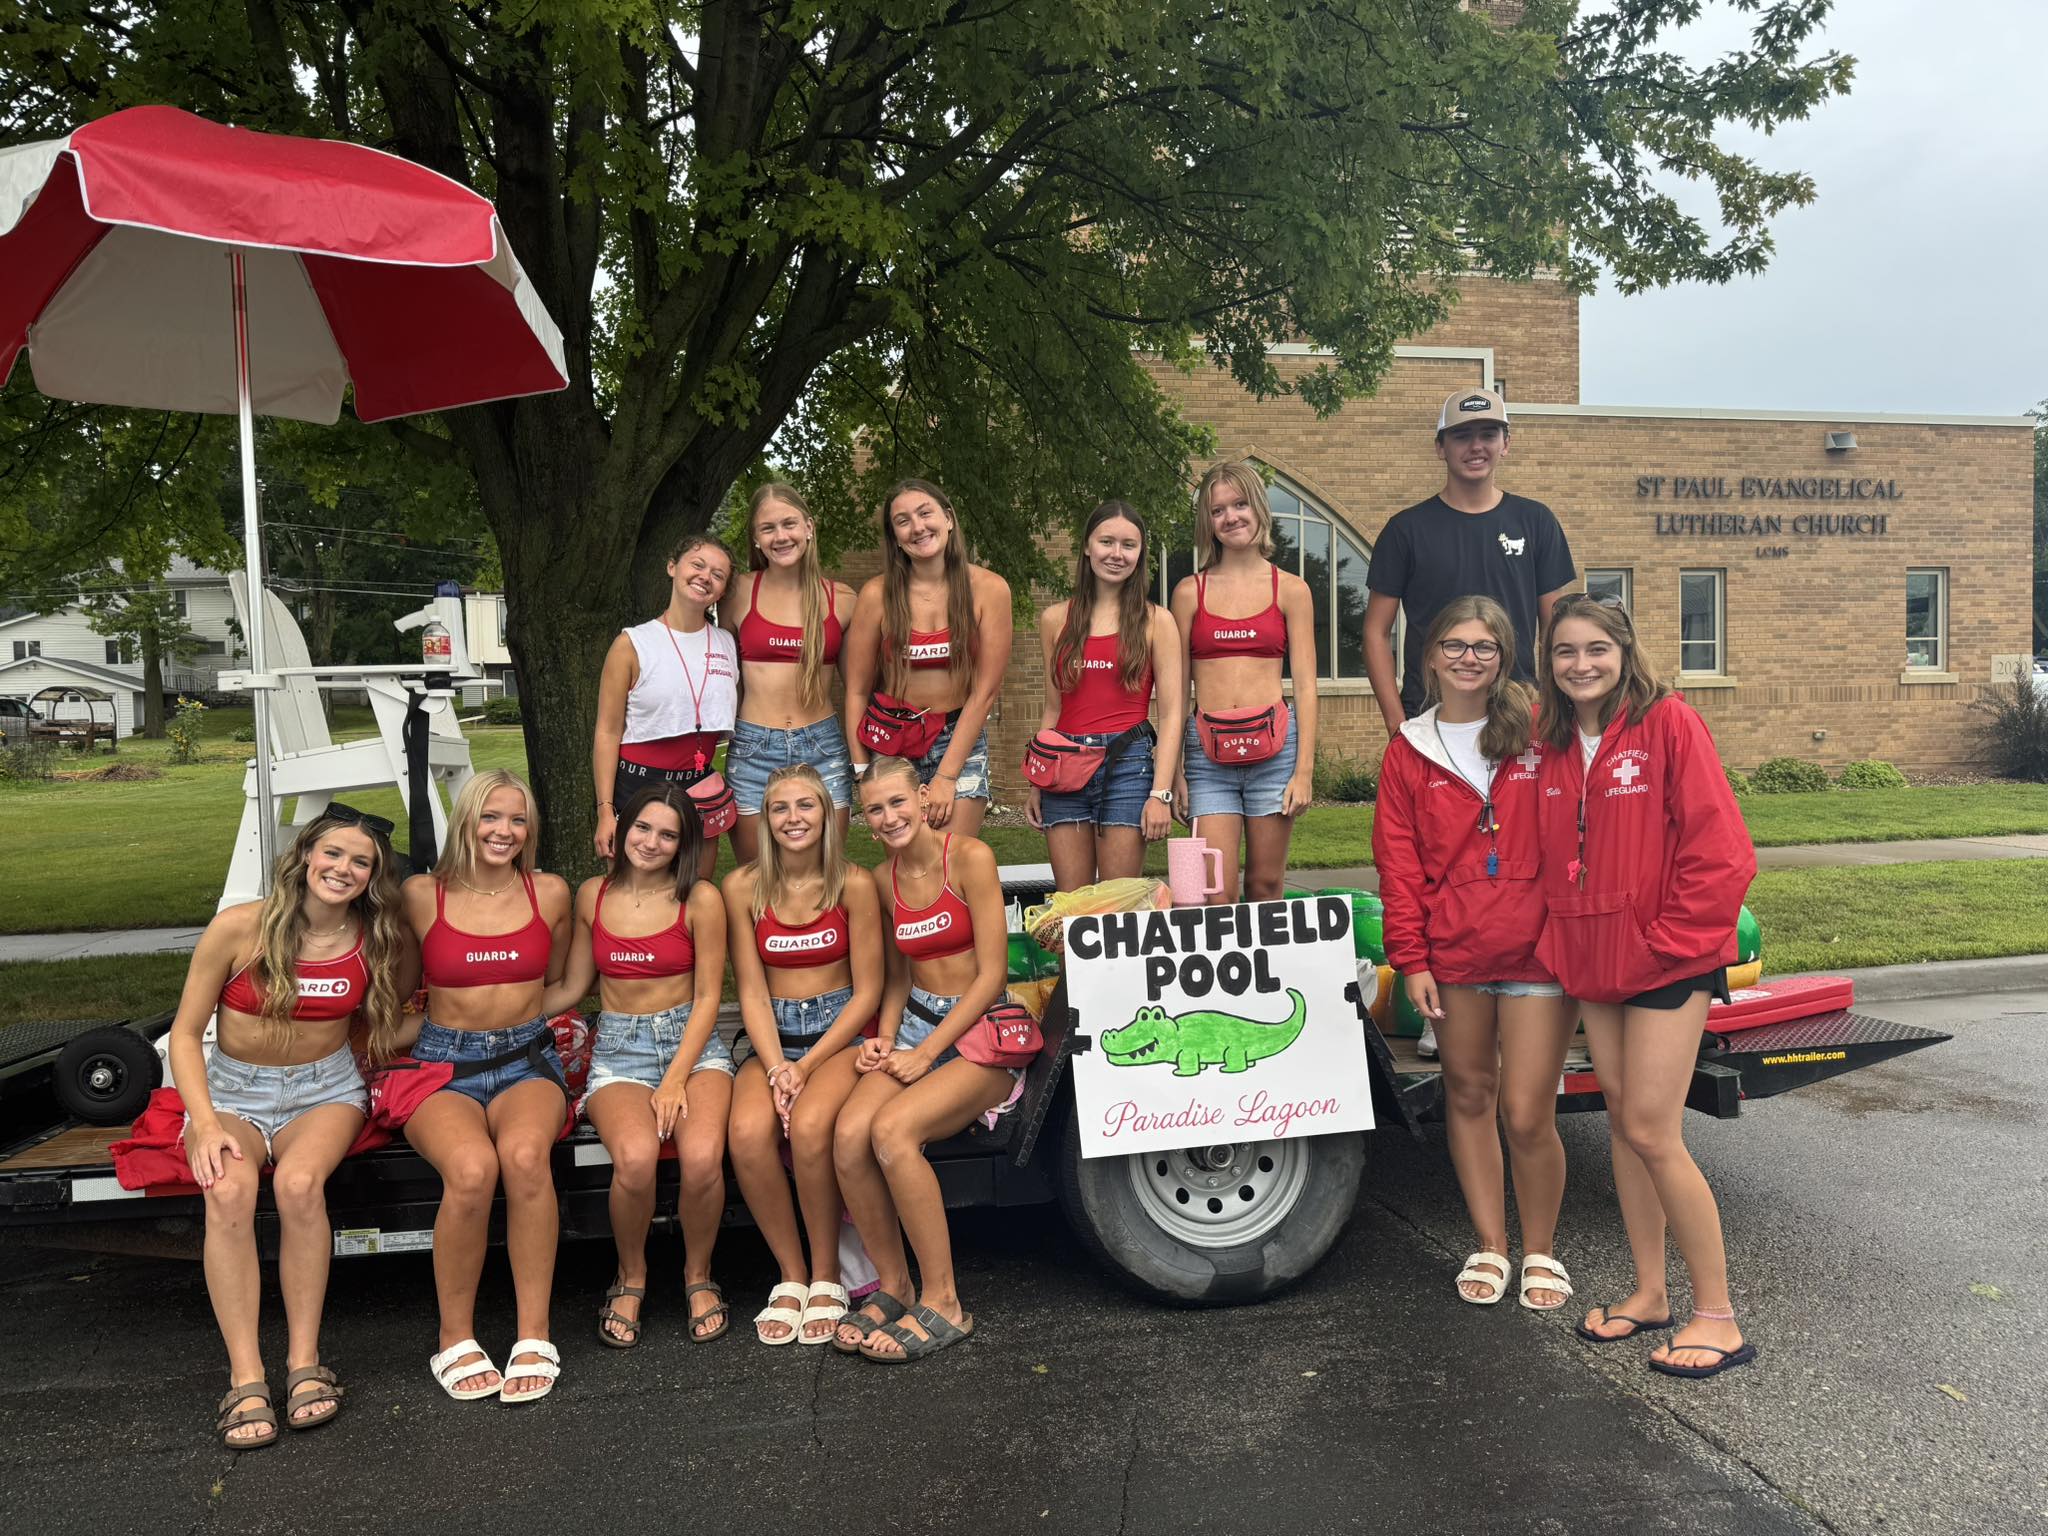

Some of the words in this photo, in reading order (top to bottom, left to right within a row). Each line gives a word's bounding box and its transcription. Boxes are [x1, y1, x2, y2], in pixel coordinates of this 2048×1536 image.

[1637, 476, 1665, 498] ST
[1674, 476, 1732, 499] PAUL
[1741, 476, 1903, 500] EVANGELICAL
[1656, 513, 1782, 536] LUTHERAN
[1793, 514, 1888, 536] CHURCH
[1756, 545, 1789, 559] LCMS
[1214, 630, 1247, 639] GUARD
[906, 646, 949, 657] UARD
[1223, 737, 1260, 749] GUARD
[1606, 749, 1649, 767] CHATFIELD
[1508, 772, 1539, 781] LIFEGU
[1605, 784, 1649, 798] LIFEGUARD
[898, 921, 936, 936] GUARD
[1068, 896, 1350, 960] CHATFIELD
[769, 937, 821, 949] GUARD
[466, 951, 508, 963] GUARD
[610, 951, 645, 962] GUARD
[1145, 948, 1281, 1001] POOL
[298, 983, 331, 993] ARD
[1762, 1051, 1847, 1065] www.hhtrailer.com
[1102, 1098, 1225, 1138] Paradise
[1233, 1090, 1341, 1138] Lagoon
